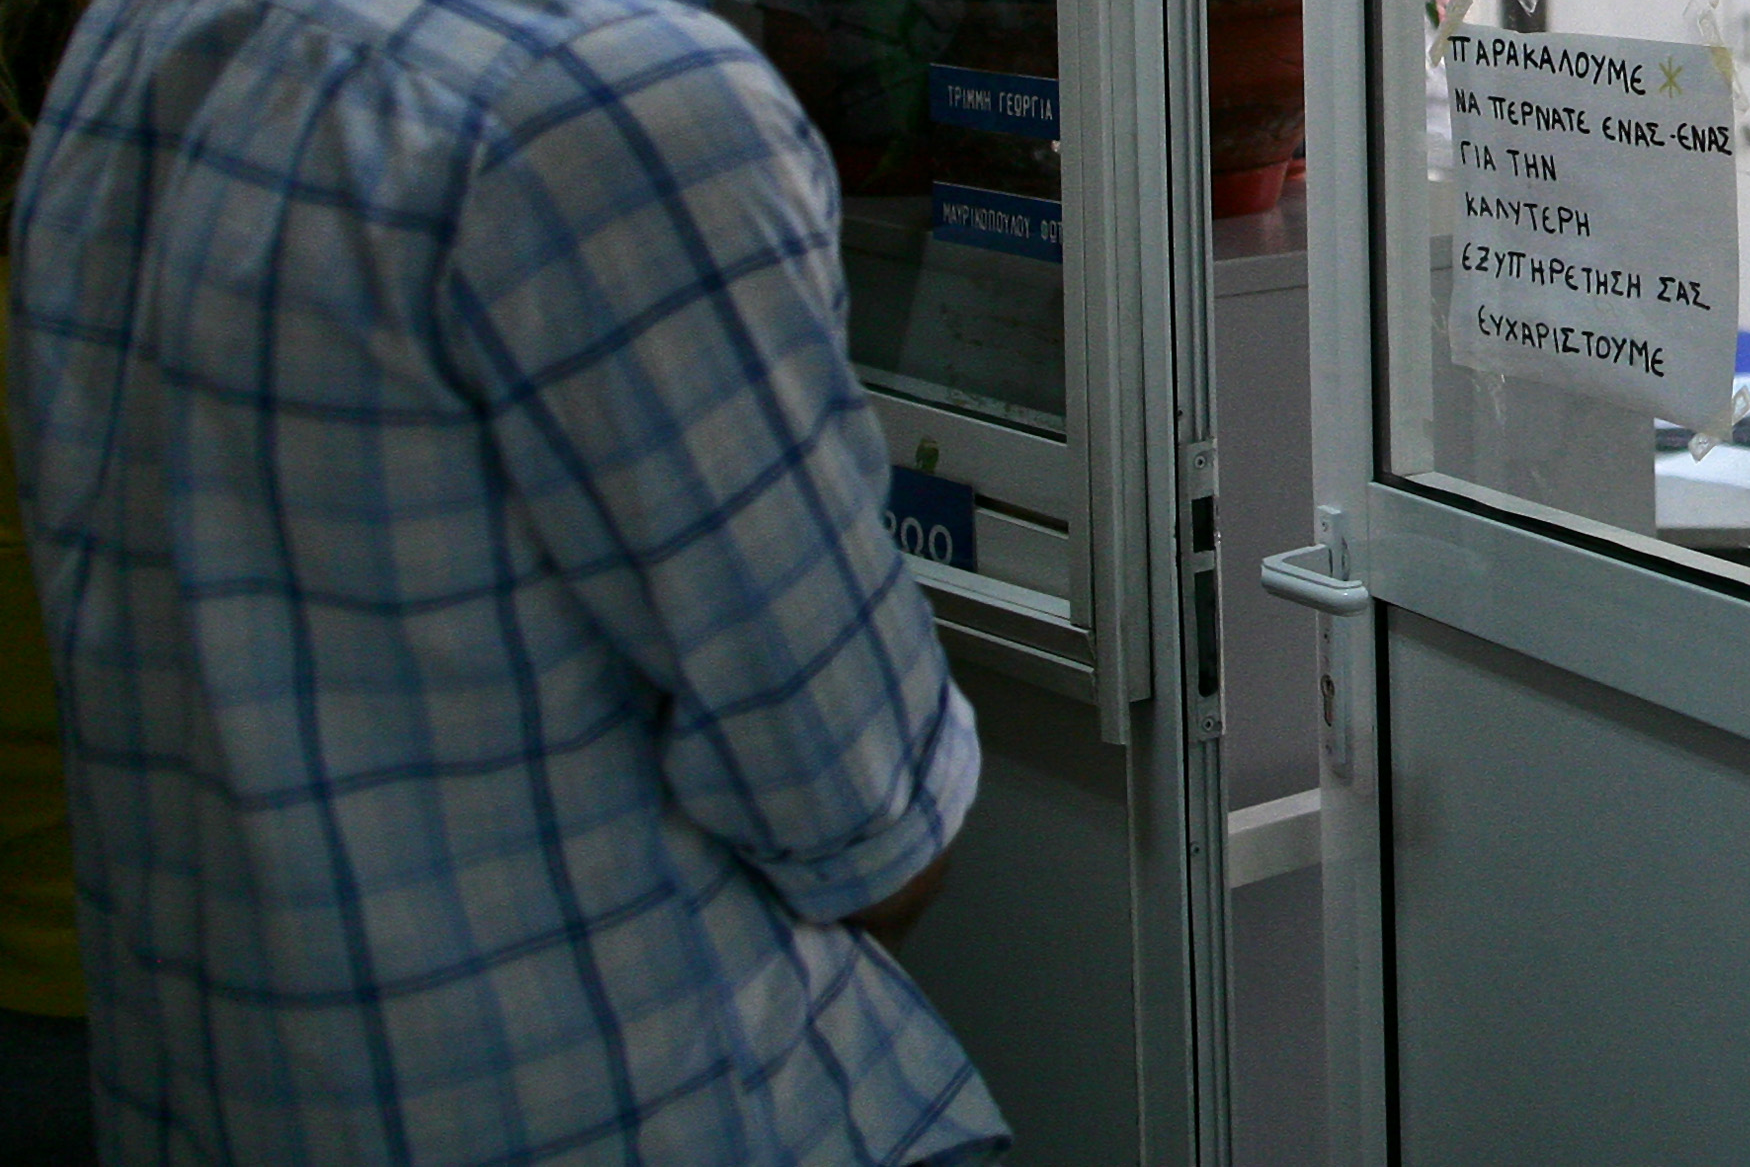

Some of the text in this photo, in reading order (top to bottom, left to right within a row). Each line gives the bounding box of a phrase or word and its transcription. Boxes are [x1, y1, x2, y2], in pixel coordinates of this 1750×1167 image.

[1447, 36, 1646, 96] ΠΑΡΑΚΑΛΟΥΜΕ
[999, 92, 1053, 121] ΓΕΩΡΓΙΑ
[1454, 88, 1482, 116] ΝΑ
[1488, 95, 1590, 134] ΠΕΡΝΑΤΕ
[1460, 141, 1557, 182] ΓΙΑ ΤΗΝ
[1465, 191, 1591, 237] ΚΑΛΥΤΕΡΗ
[1657, 277, 1711, 311] ΣΑΣ
[1478, 304, 1664, 378] ΕΥΧΑΡΙΣΤΟΥΜΕ
